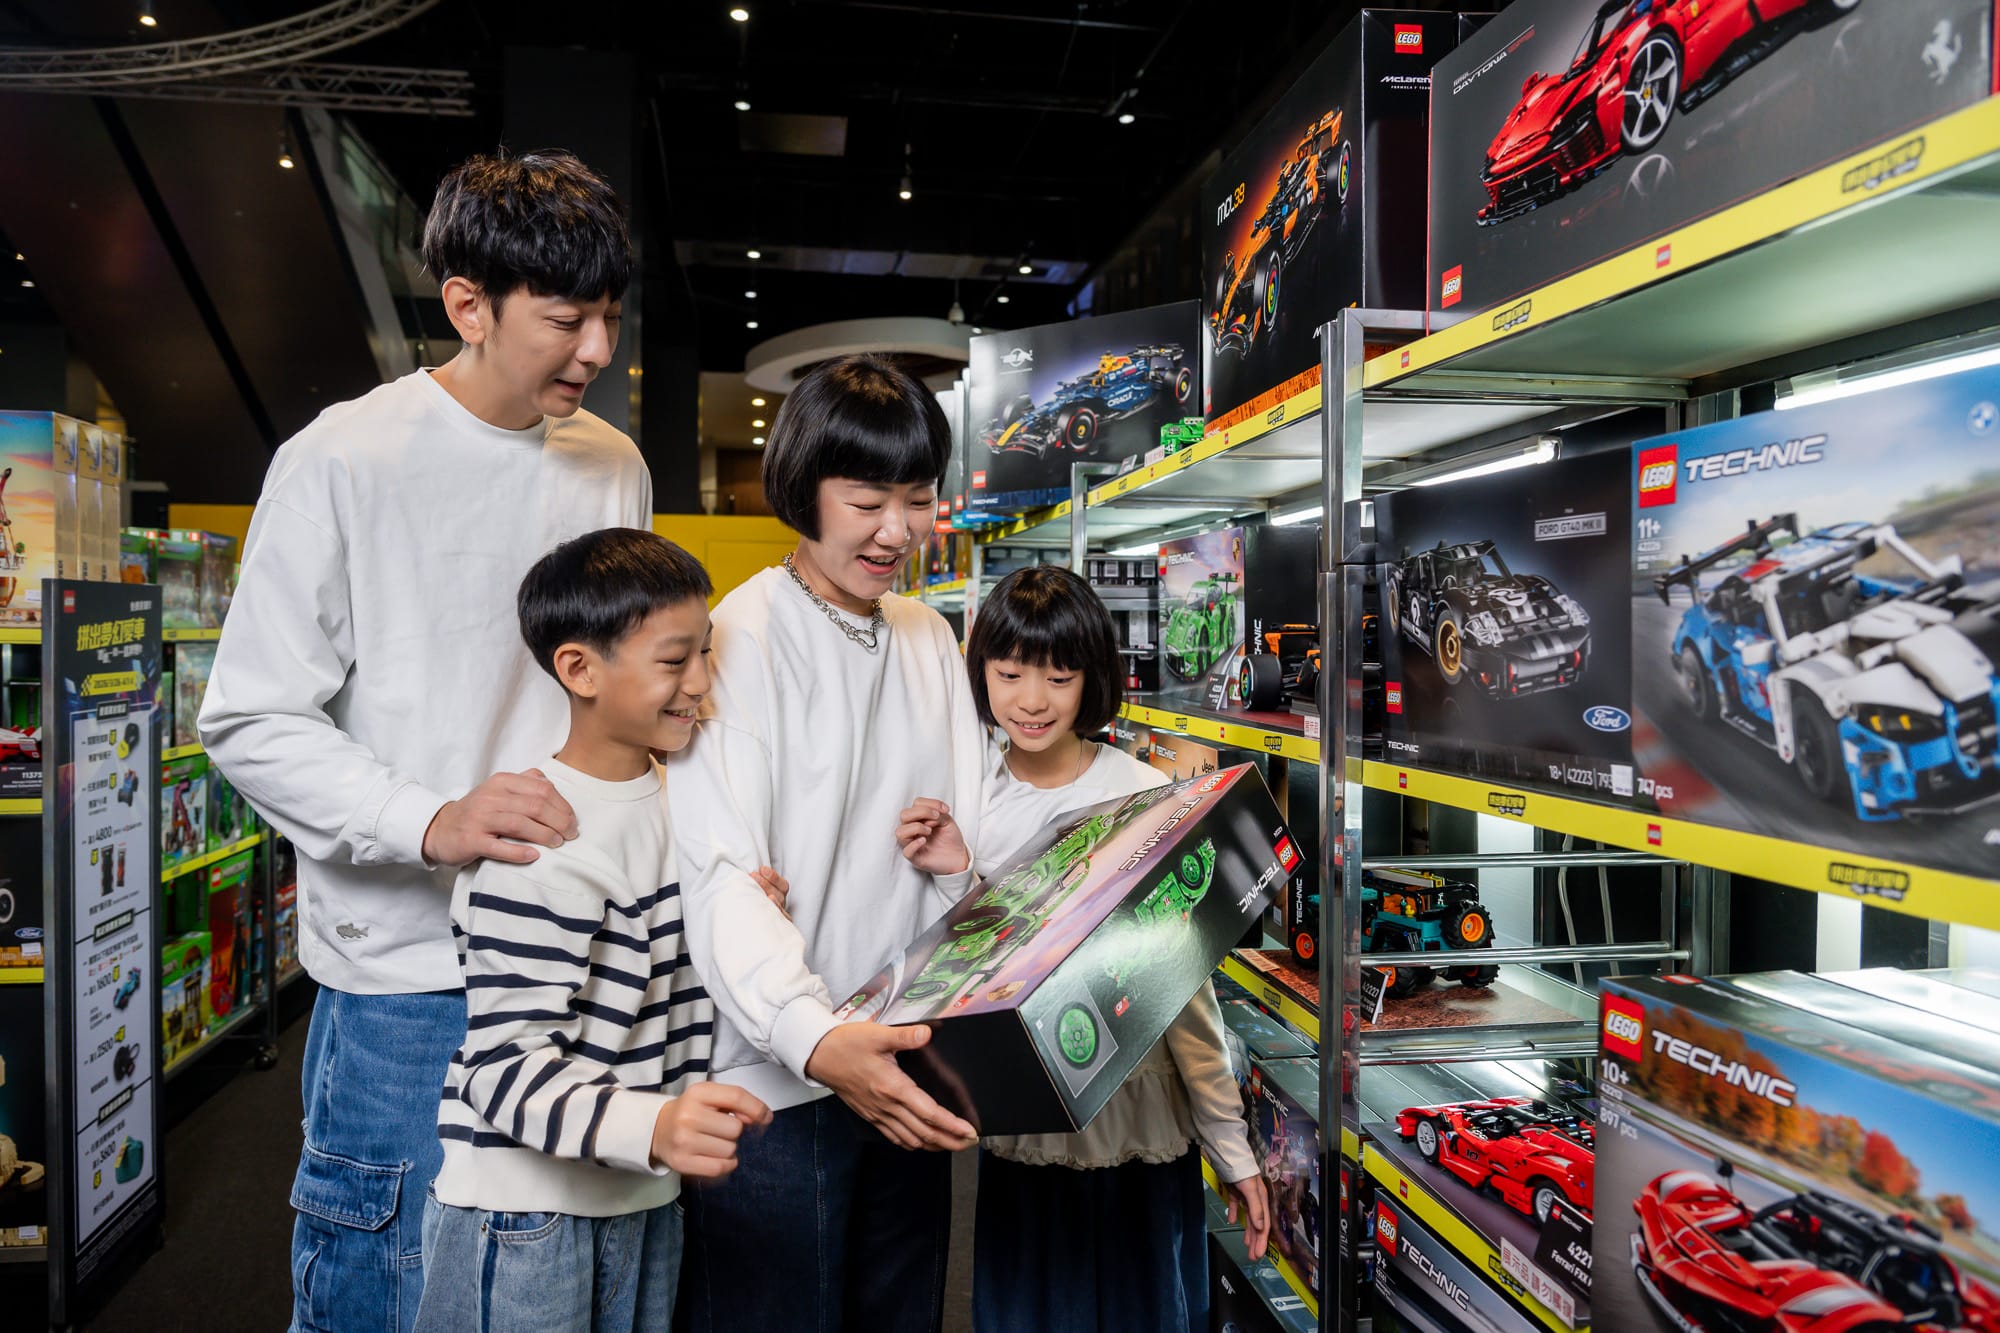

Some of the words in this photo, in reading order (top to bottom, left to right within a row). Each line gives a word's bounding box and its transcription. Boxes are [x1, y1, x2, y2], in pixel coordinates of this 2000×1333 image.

[1396, 32, 1421, 45] LEGO
[1380, 75, 1432, 83] McLaren
[1453, 51, 1508, 95] DAYTONA
[1442, 276, 1461, 298] LEGO
[1640, 462, 1675, 491] LEGO
[1684, 434, 1828, 482] TECHNIC
[1539, 523, 1559, 535] FORD
[1561, 521, 1580, 533] GT40
[1637, 518, 1661, 539] 11+
[1592, 708, 1621, 728] Ford
[1387, 740, 1419, 752] TECHNIC
[1656, 785, 1673, 800] pcs
[1119, 796, 1202, 872] TECHNIC
[1237, 861, 1280, 914] TECHNIC
[1601, 1058, 1630, 1085] 10+
[1605, 1011, 1642, 1044] LEGO
[1651, 1029, 1797, 1107] TECHNIC
[1262, 1084, 1289, 1118] TECHNIC
[1600, 1106, 1619, 1128] 897
[1619, 1119, 1638, 1140] pcs
[1376, 1250, 1387, 1269] 9+
[1378, 1214, 1397, 1243] LEGO
[1401, 1235, 1470, 1311] TECHNIC
[1551, 1248, 1575, 1274] Ferrari
[1567, 1241, 1593, 1269] 4221
